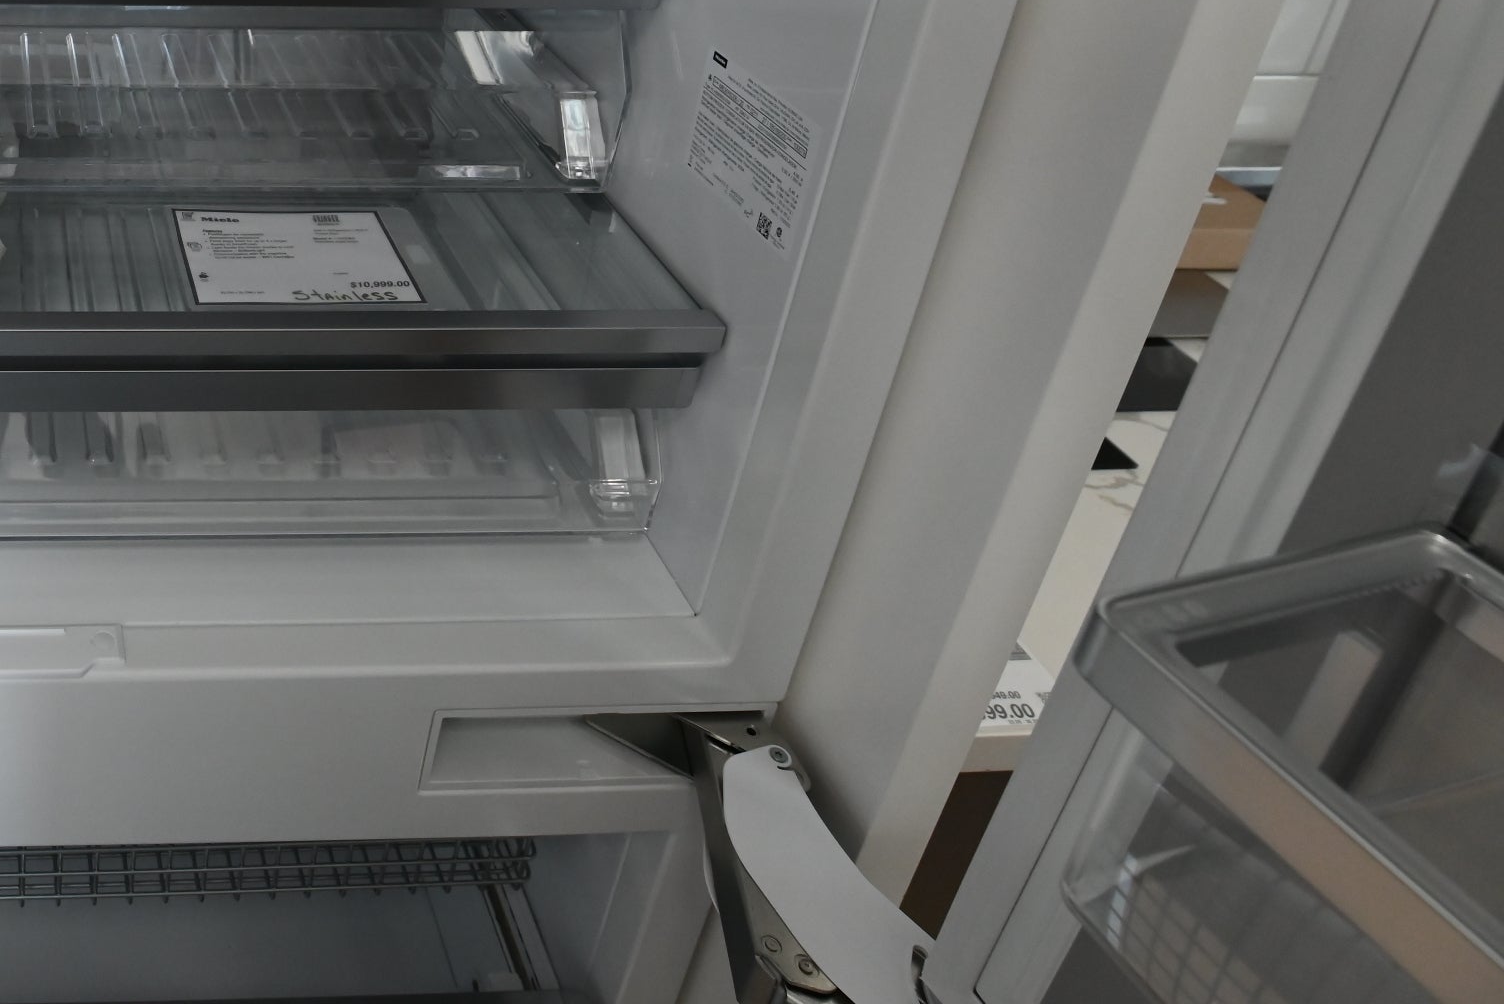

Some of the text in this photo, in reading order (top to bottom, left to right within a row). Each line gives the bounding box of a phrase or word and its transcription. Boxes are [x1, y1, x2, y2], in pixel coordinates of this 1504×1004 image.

[350, 280, 410, 289] $10,999.00
[292, 289, 399, 302] Stainless
[982, 703, 1035, 720] 99.00
